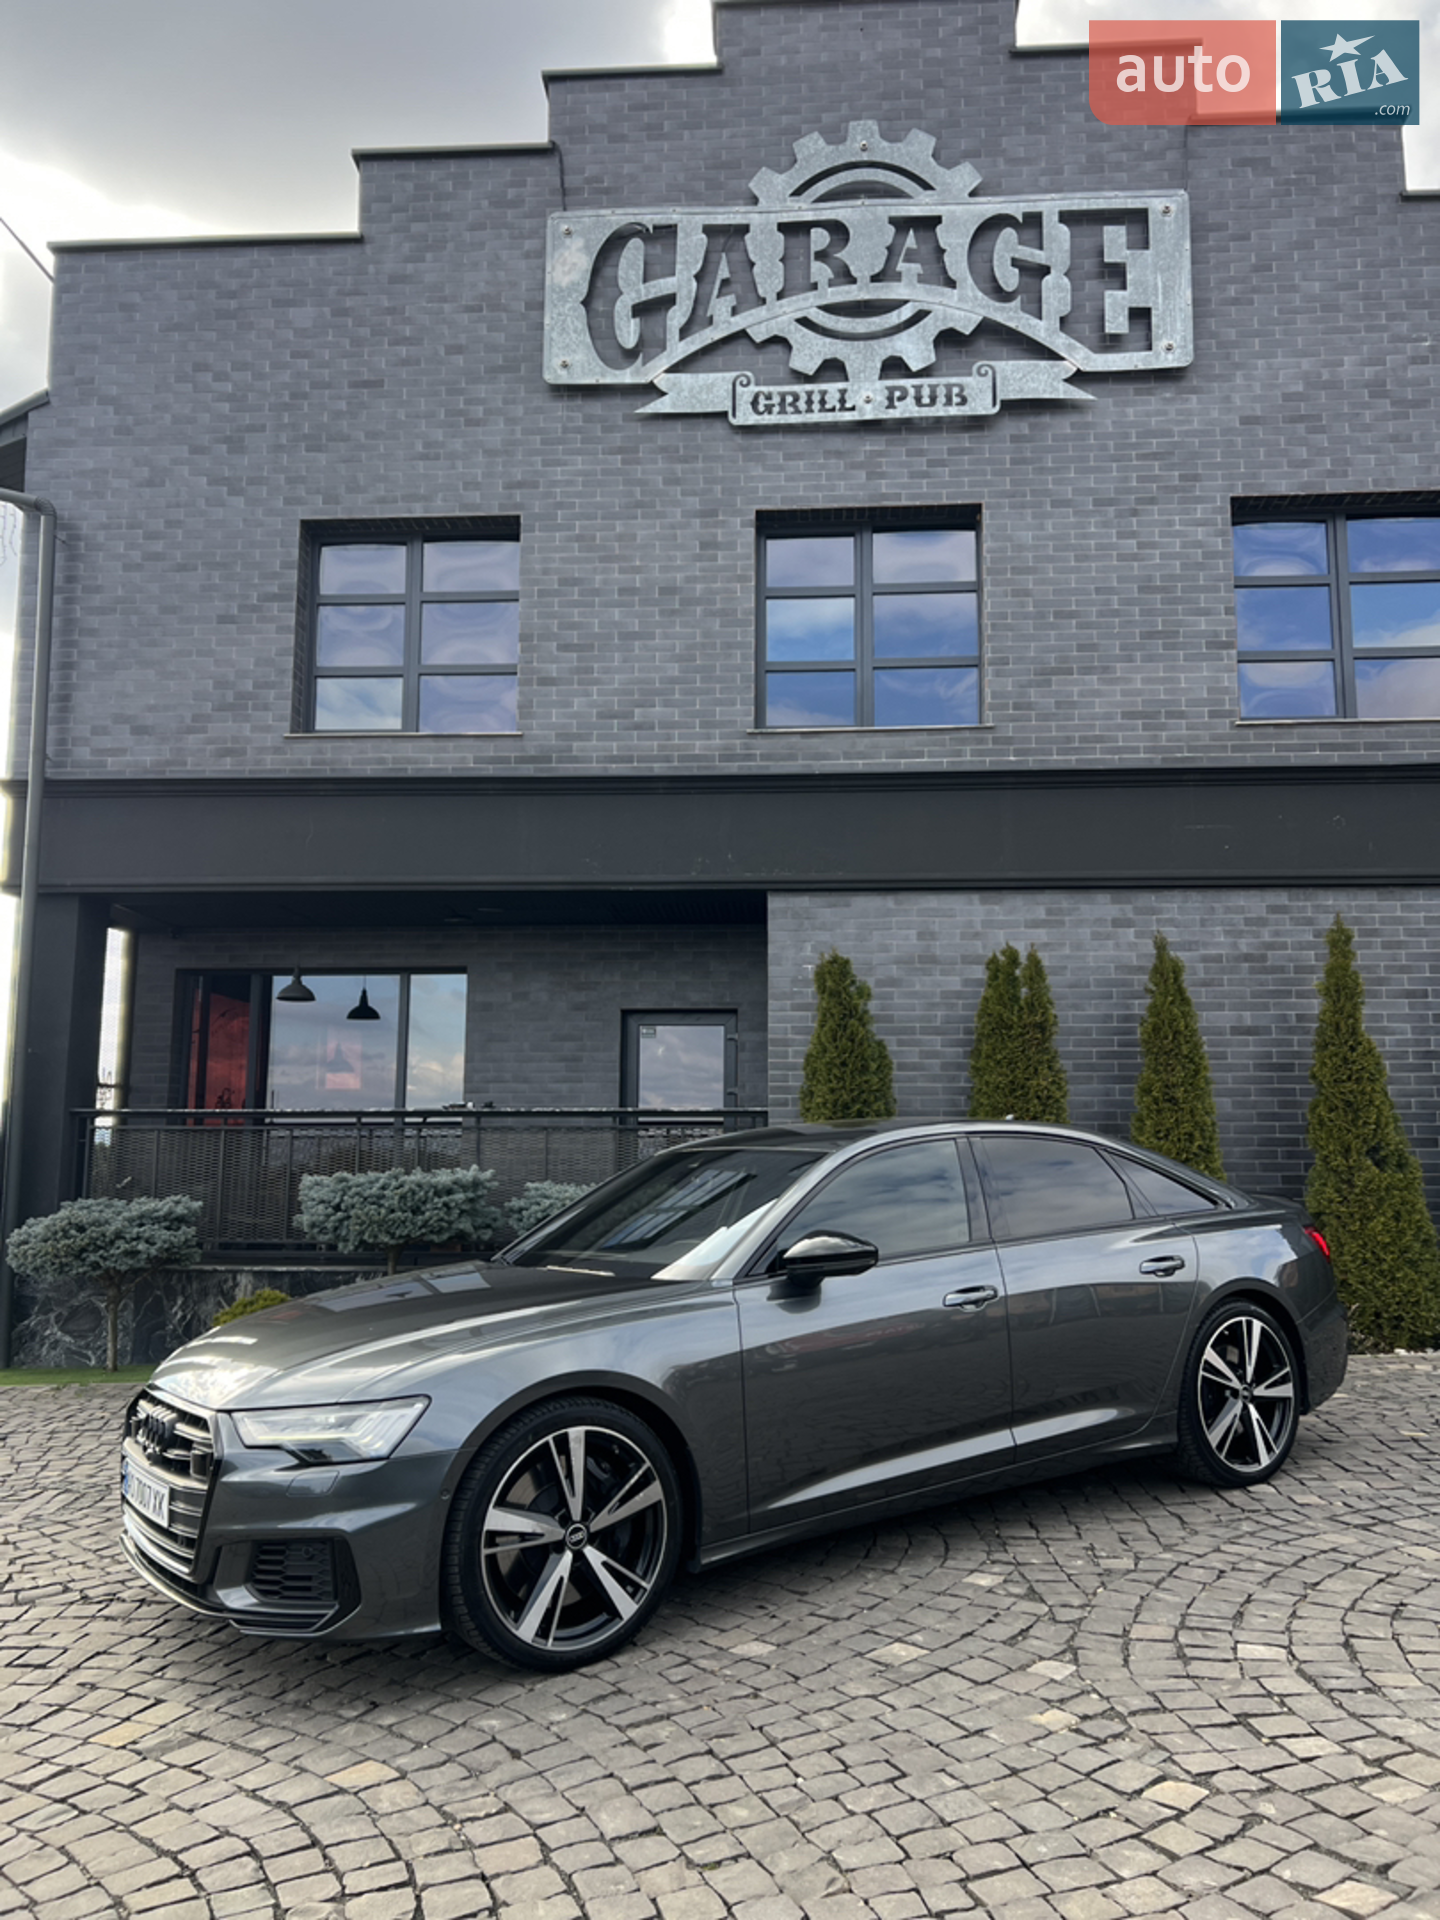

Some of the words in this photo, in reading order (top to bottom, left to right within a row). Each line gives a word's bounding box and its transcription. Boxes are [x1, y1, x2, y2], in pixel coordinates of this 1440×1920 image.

[580, 206, 1153, 371] GARAGE
[750, 388, 856, 416] GRILL
[884, 383, 968, 409] PUB
